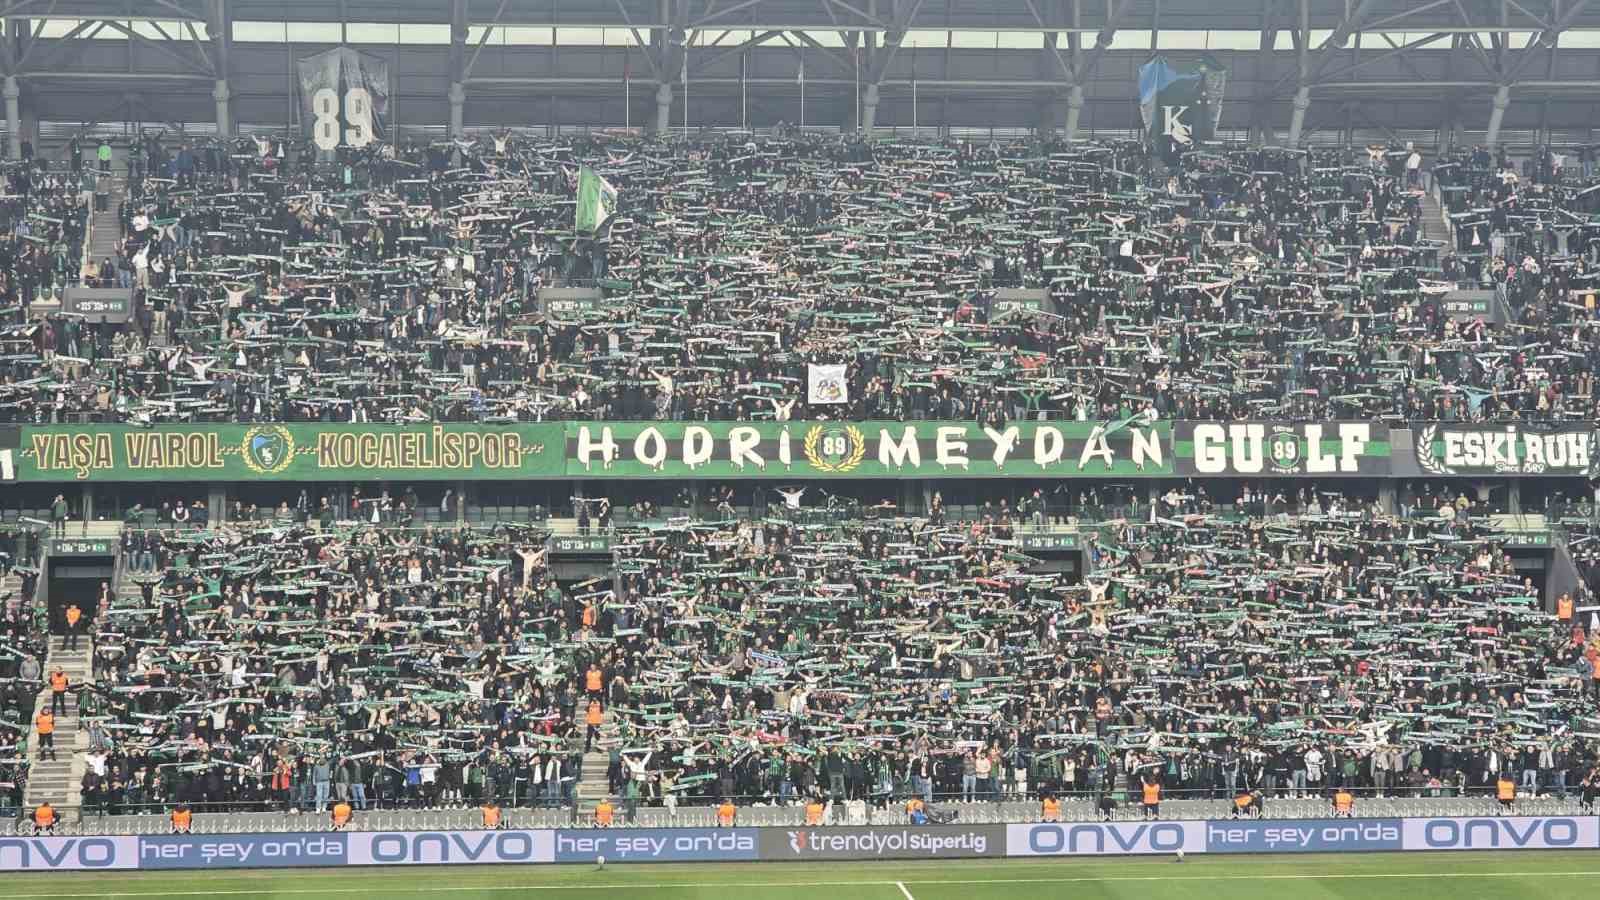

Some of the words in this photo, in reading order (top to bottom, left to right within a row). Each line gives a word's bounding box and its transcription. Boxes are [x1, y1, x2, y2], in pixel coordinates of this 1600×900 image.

[312, 88, 373, 150] 89
[32, 433, 113, 479] YAŞA
[125, 432, 224, 468] VAROL
[318, 425, 521, 468] KOCAELİSPOR
[823, 437, 846, 455] 89
[878, 425, 1163, 471] MEYDAN
[1274, 441, 1296, 459] 89
[1443, 425, 1518, 466] ESKİ
[1523, 432, 1590, 467] RUH
[371, 832, 532, 862] onvo
[557, 833, 607, 852] her
[615, 836, 667, 857] şey
[675, 831, 754, 851] on'da
[809, 830, 907, 853] trendyol
[1029, 823, 1184, 852] onvo
[1208, 825, 1256, 844] her
[1264, 827, 1315, 848] şey
[1322, 822, 1398, 842] on'da
[1425, 818, 1578, 847] onvo
[141, 840, 192, 858] her
[201, 842, 254, 863] şey
[262, 838, 344, 857] on'da
